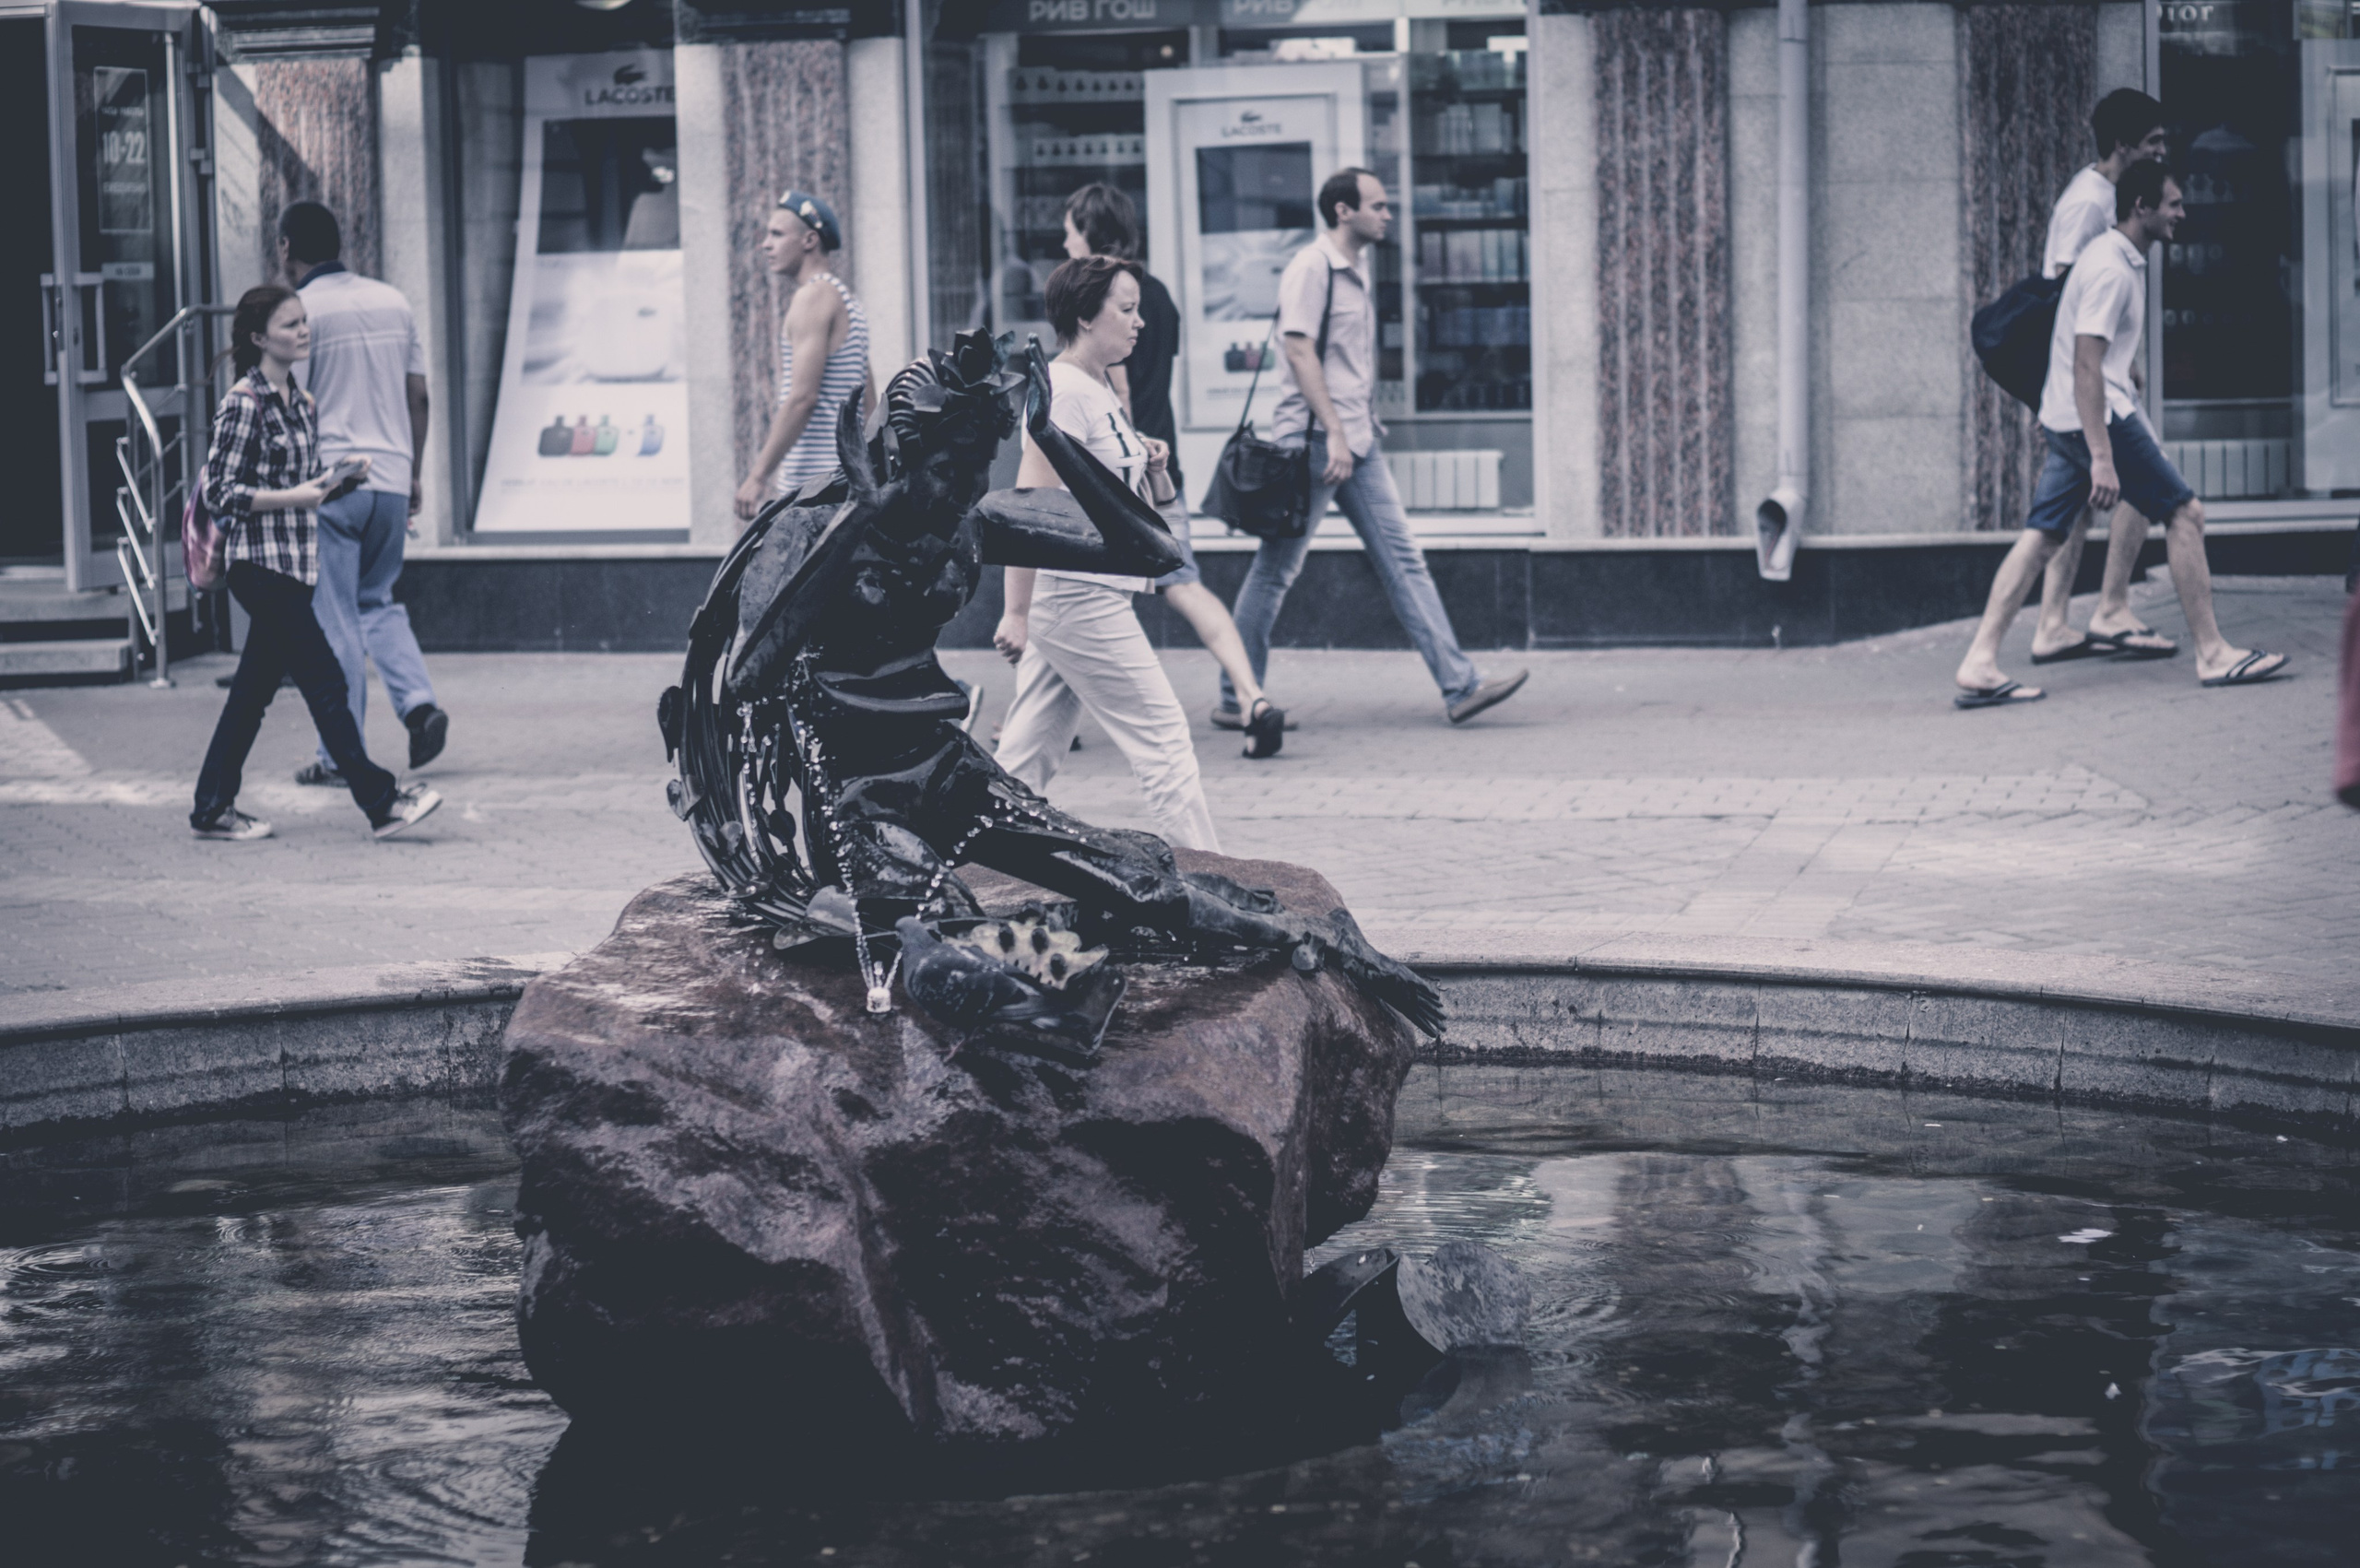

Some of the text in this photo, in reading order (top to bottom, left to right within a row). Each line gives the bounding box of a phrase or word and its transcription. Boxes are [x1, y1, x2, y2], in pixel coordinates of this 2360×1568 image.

[1029, 0, 1157, 21] РИВ ГОШ
[584, 86, 675, 106] LACOSTE
[1220, 123, 1282, 138] LACOSTE
[102, 130, 147, 164] 10-22
